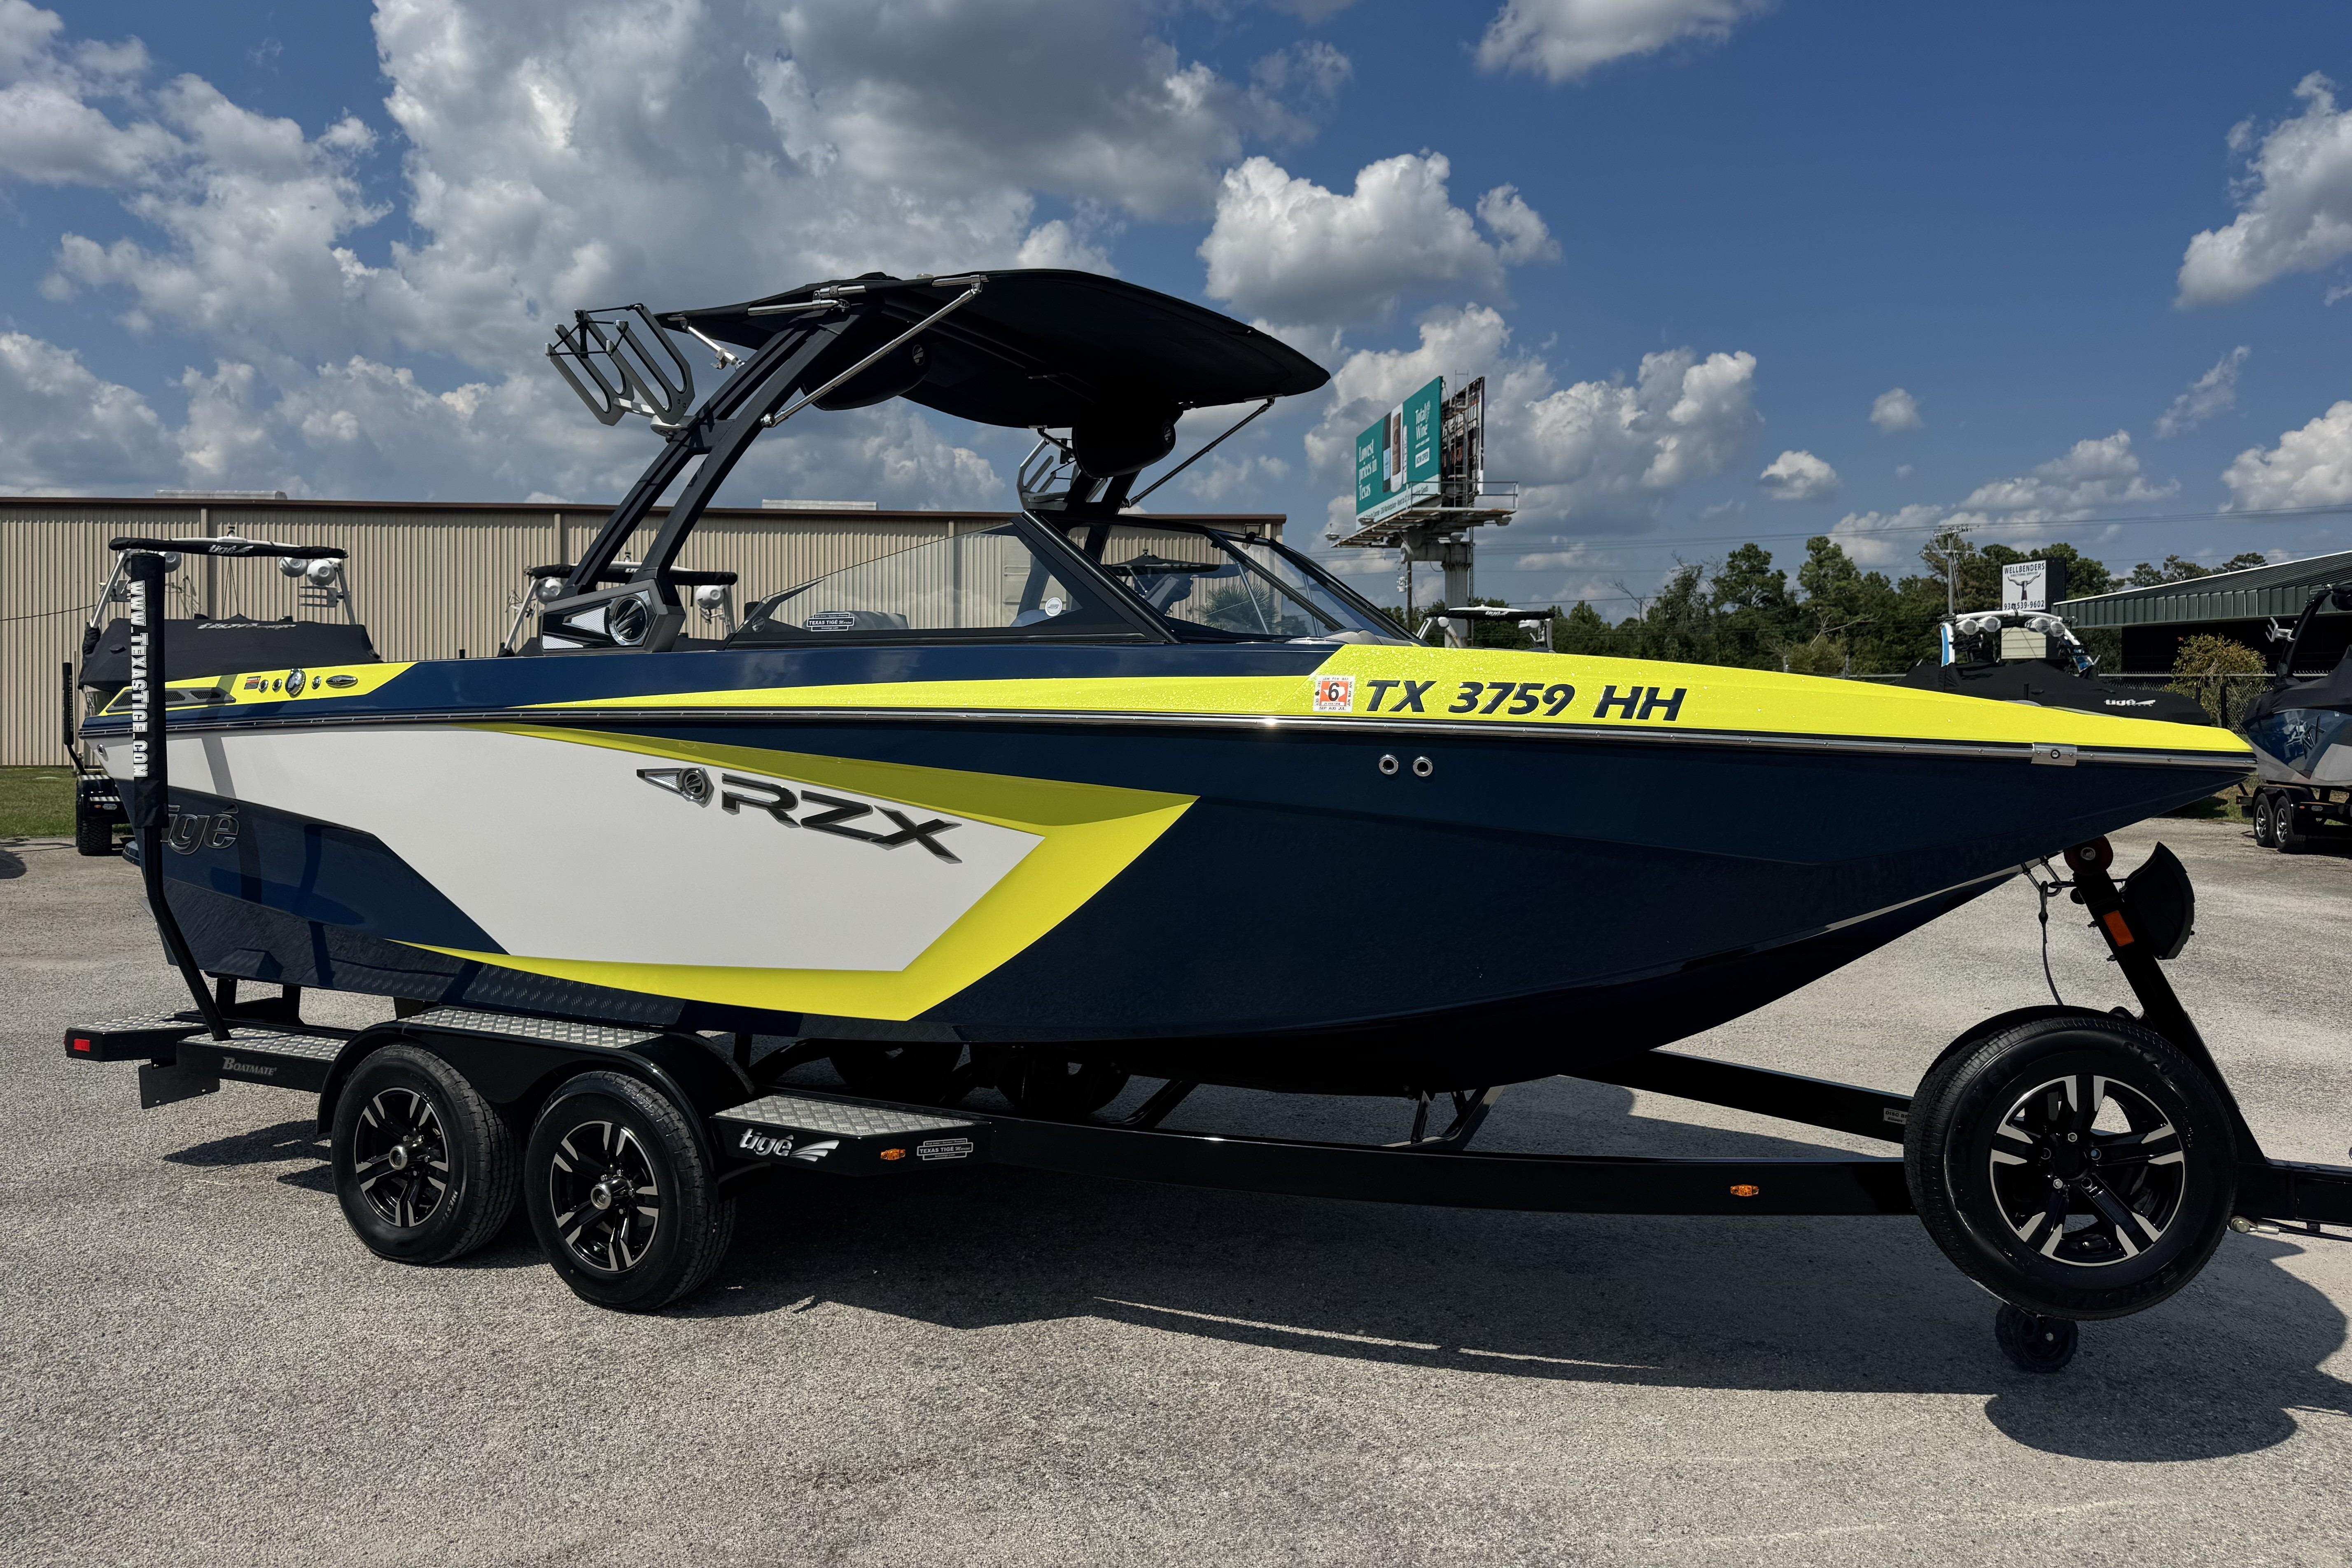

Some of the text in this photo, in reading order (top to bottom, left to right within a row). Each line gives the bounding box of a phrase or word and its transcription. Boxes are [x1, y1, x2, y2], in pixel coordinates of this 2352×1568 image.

[1416, 423, 1428, 441] Wine
[1359, 438, 1374, 462] Lowest
[1359, 461, 1372, 485] prices
[1372, 455, 1377, 473] in
[1359, 483, 1371, 501] Texas
[2004, 562, 2044, 574] WELLBENDERS
[1328, 682, 1339, 701] 6
[1367, 680, 1687, 721] TX 3759 HH
[161, 804, 240, 855] igé
[721, 772, 963, 864] RZX
[740, 1128, 794, 1156] tigé
